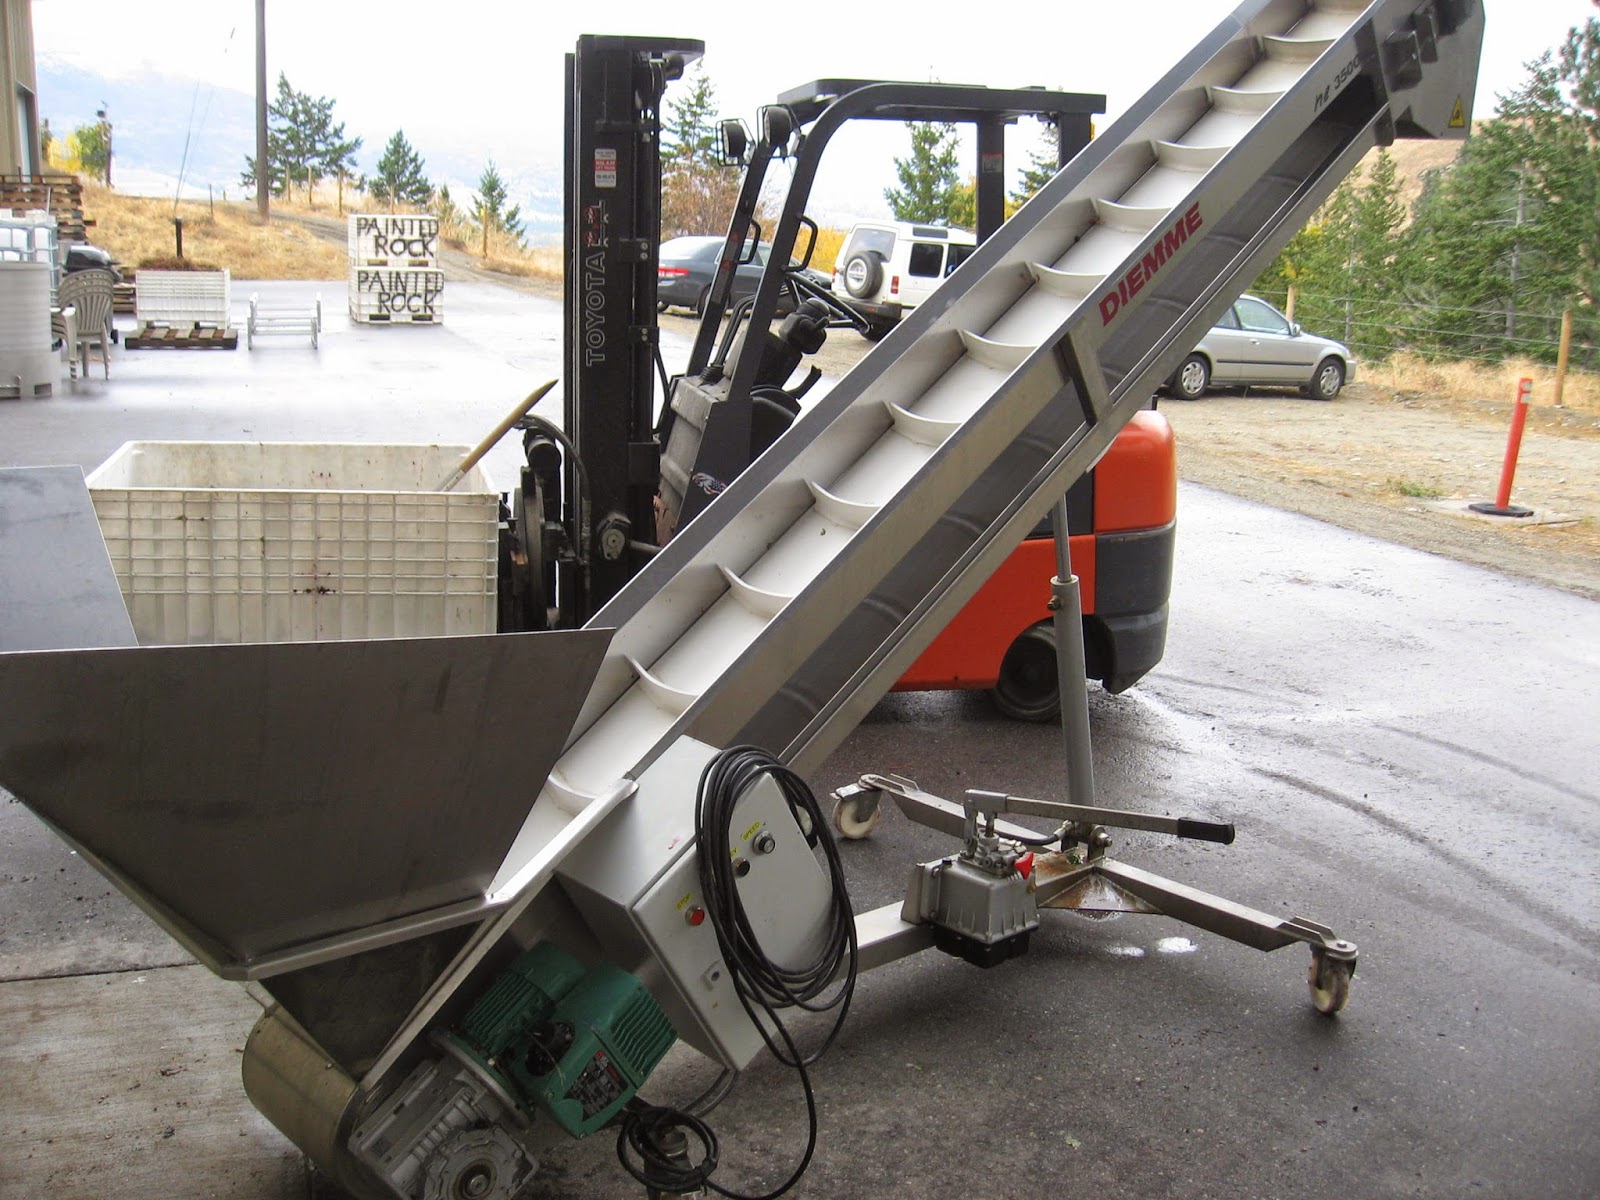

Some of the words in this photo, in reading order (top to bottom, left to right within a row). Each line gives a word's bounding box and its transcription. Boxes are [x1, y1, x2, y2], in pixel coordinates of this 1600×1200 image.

[356, 217, 439, 237] PAINTED
[374, 235, 434, 257] ROCK
[1099, 201, 1203, 327] DIEMME
[357, 270, 444, 292] PAINTED
[377, 291, 434, 314] ROCK
[586, 251, 606, 367] TOYOTA
